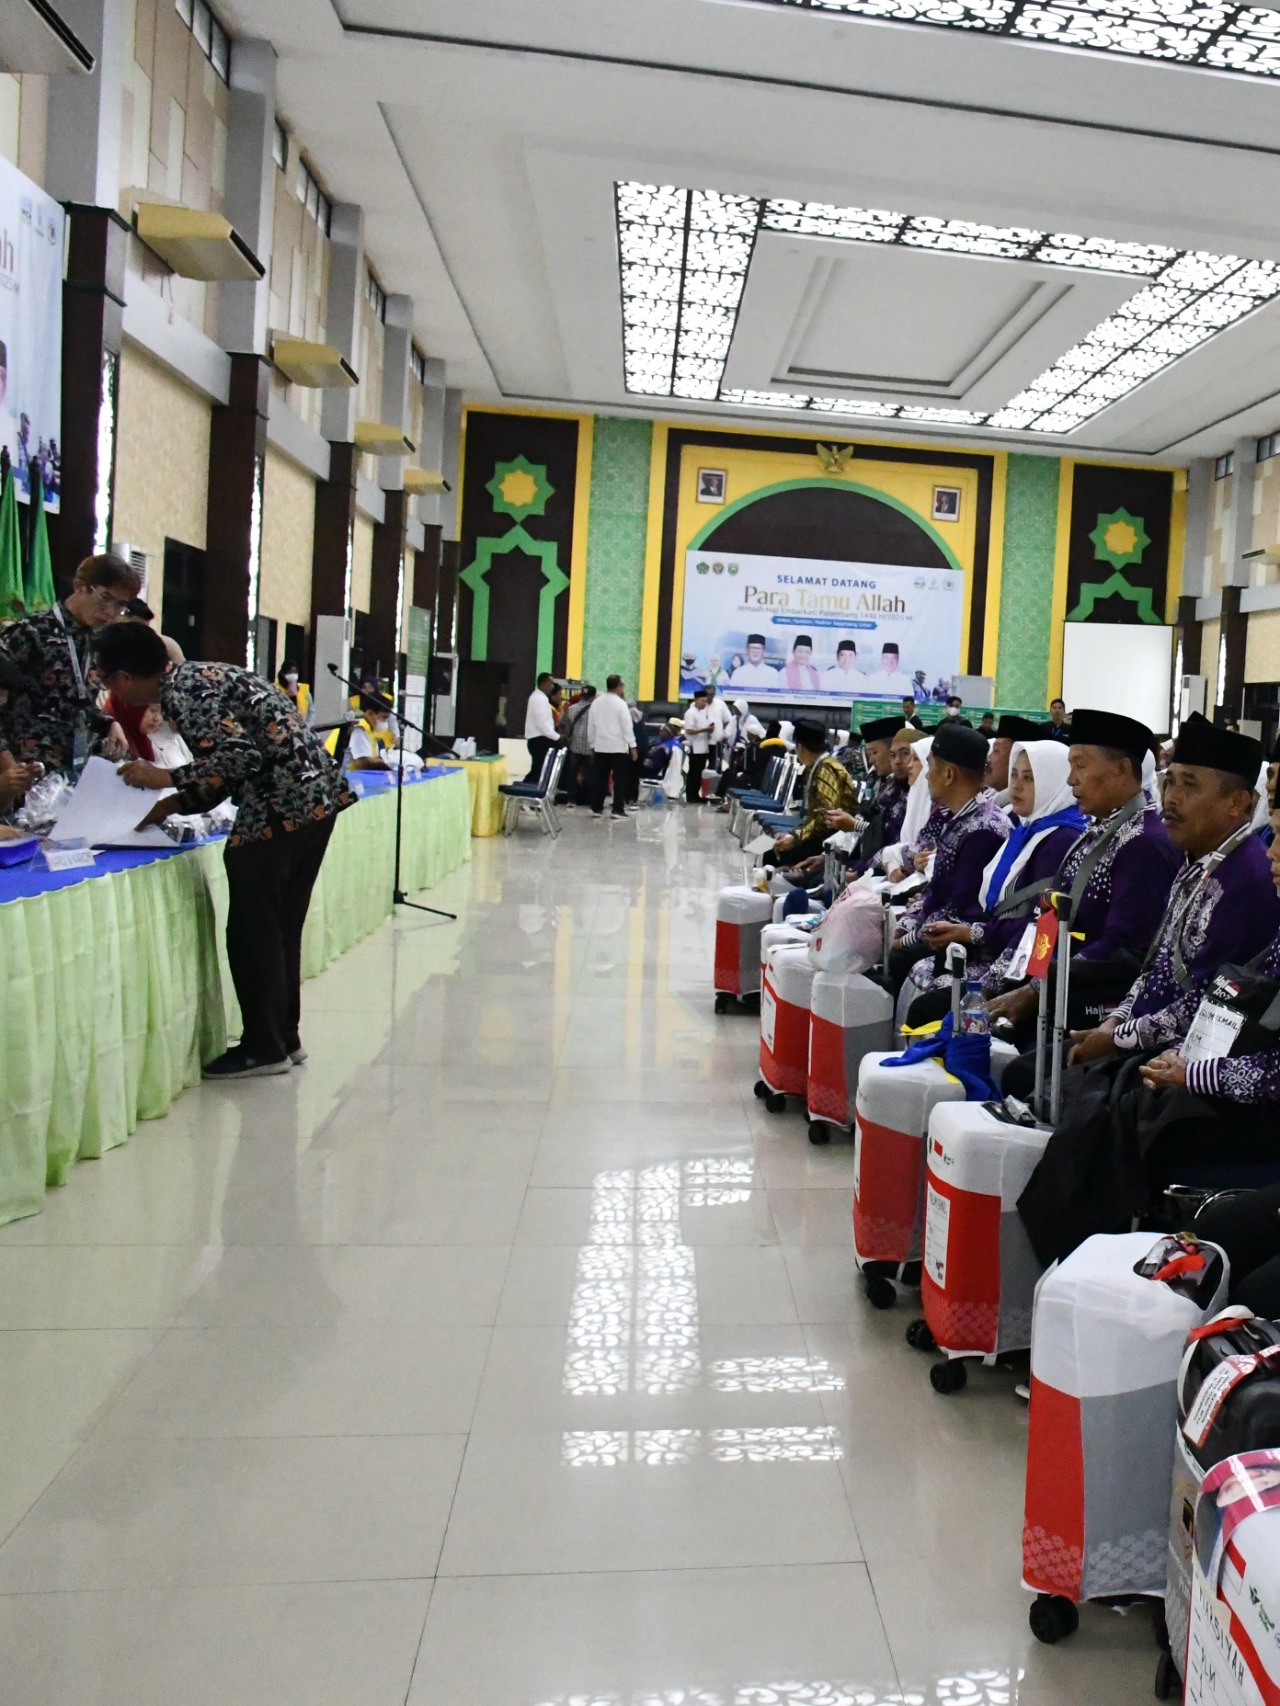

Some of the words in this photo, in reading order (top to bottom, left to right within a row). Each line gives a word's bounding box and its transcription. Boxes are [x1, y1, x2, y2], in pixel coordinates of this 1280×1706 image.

[777, 574, 828, 586] SELAMAT
[832, 578, 877, 589] DATANG
[744, 585, 790, 607] Para
[796, 589, 850, 610] Tamu
[857, 592, 906, 613] Allah
[819, 610, 858, 619] Palembang
